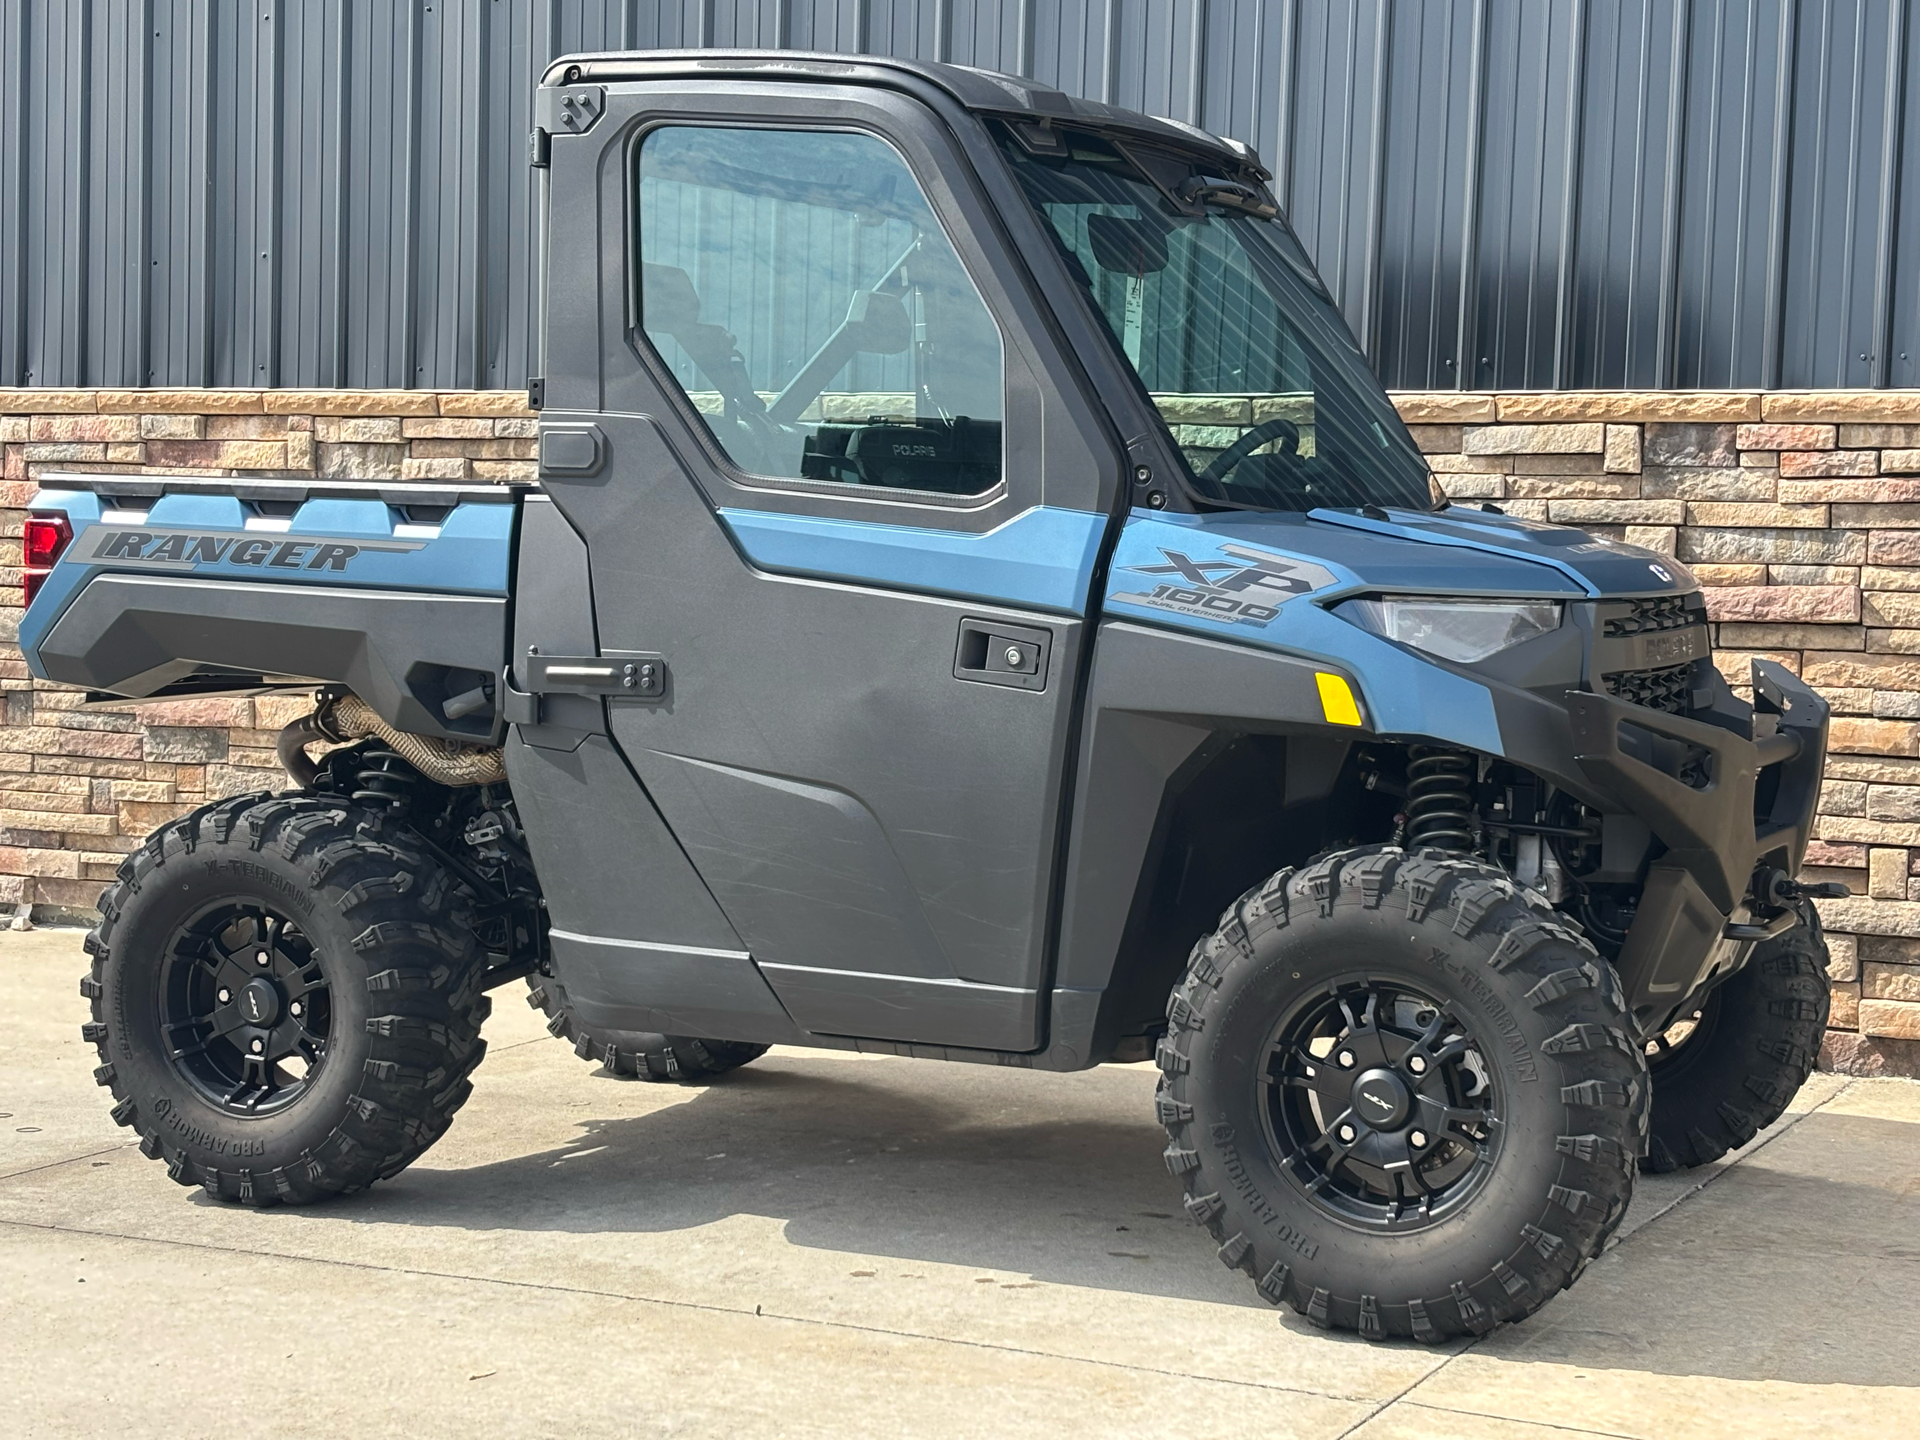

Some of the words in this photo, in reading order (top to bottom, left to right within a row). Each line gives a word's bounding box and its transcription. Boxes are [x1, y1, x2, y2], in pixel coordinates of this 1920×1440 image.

[892, 444, 936, 457] POLARIS
[99, 531, 360, 573] RANGER
[1118, 547, 1317, 595] XP
[1146, 599, 1176, 611] DUAL
[1177, 605, 1239, 622] OVERHEAD
[1151, 583, 1281, 622] 1000
[1425, 946, 1538, 1083] X-TERRAIN
[168, 1113, 228, 1154] ARMOR
[230, 1139, 264, 1157] PRO
[1221, 1144, 1279, 1226] ARMOR
[1274, 1223, 1320, 1261] PRO
